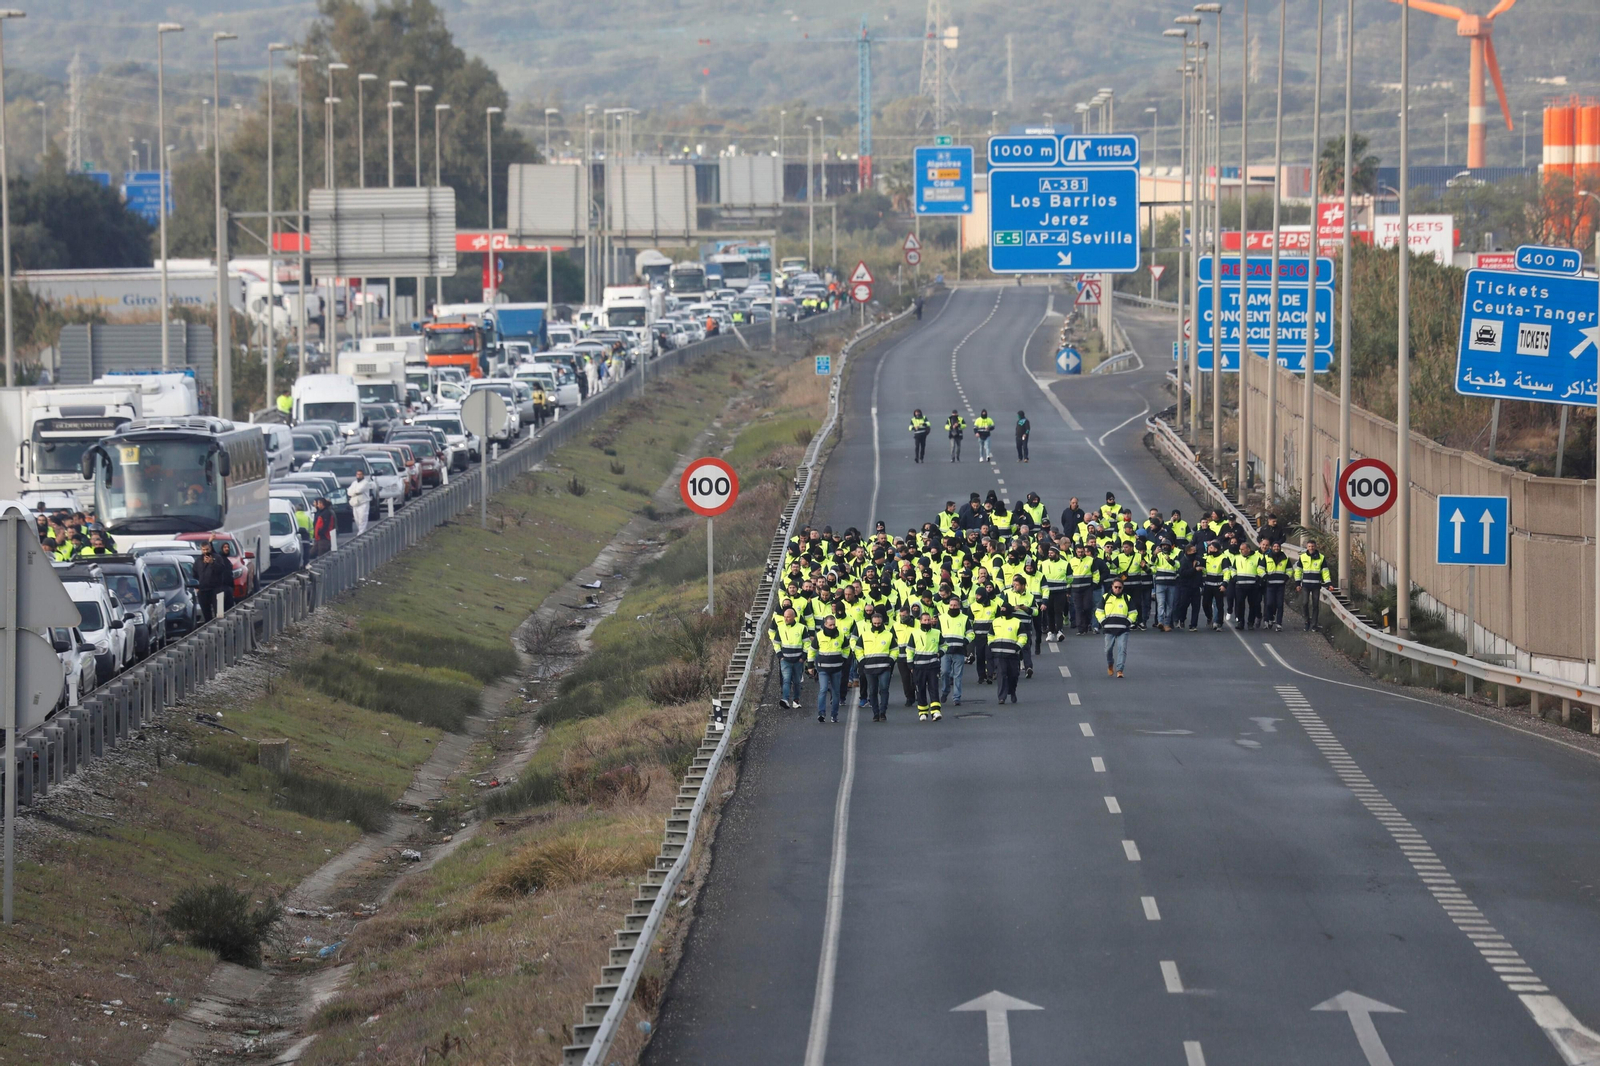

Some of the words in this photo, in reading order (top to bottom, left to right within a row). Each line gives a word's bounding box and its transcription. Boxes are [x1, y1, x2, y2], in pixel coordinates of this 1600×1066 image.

[994, 145, 1033, 157] 1000
[1040, 148, 1053, 157] m
[1096, 144, 1132, 157] 1115A
[1041, 179, 1087, 191] A-381
[1010, 194, 1041, 208] Los
[1050, 193, 1117, 207] Barrios
[1039, 212, 1089, 226] Jerez
[996, 233, 1021, 244] E-5
[1028, 232, 1067, 244] AP-4
[1072, 231, 1132, 244] Sevilla
[1262, 232, 1311, 248] CEPS
[1521, 253, 1555, 266] 400
[1562, 258, 1575, 268] m
[1212, 263, 1320, 277] RECAUCIÓ
[1475, 280, 1549, 299] Tickets
[123, 293, 157, 305] Giro
[160, 292, 202, 304] rans
[1229, 293, 1280, 306] TAM
[1282, 294, 1301, 306] DE
[1472, 299, 1595, 324] Ceuta-Tanger
[1520, 329, 1549, 350] TICKETS
[690, 477, 730, 496] 100
[1348, 478, 1389, 497] 100
